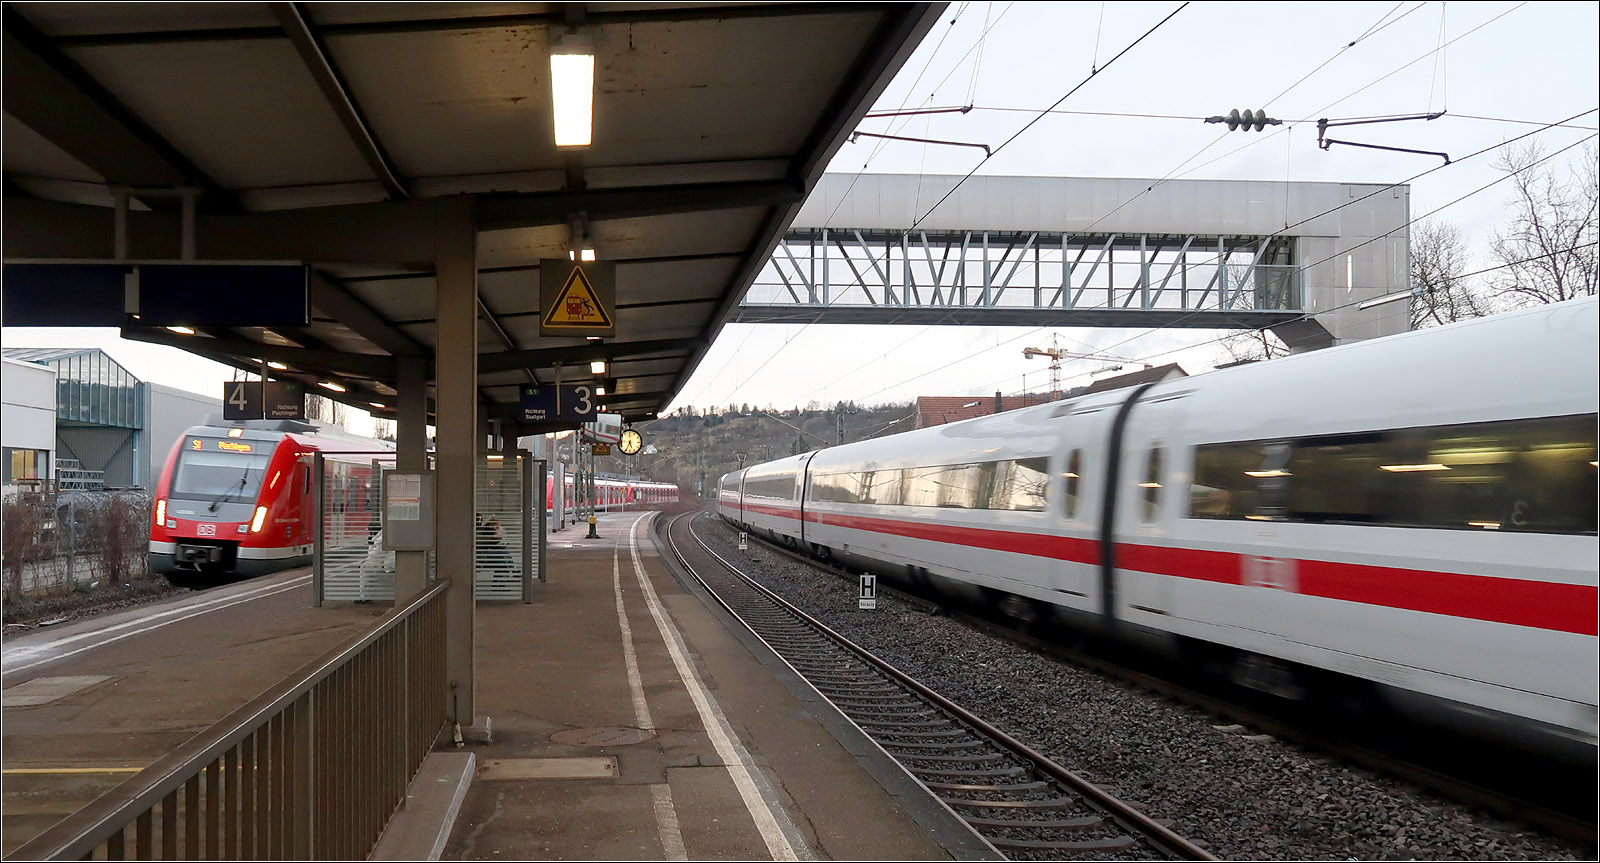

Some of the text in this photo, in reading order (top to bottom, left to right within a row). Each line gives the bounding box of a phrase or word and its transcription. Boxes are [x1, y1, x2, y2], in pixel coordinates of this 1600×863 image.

[228, 382, 248, 411] 4
[573, 385, 592, 415] 3
[740, 533, 747, 544] H
[861, 576, 875, 597] H
